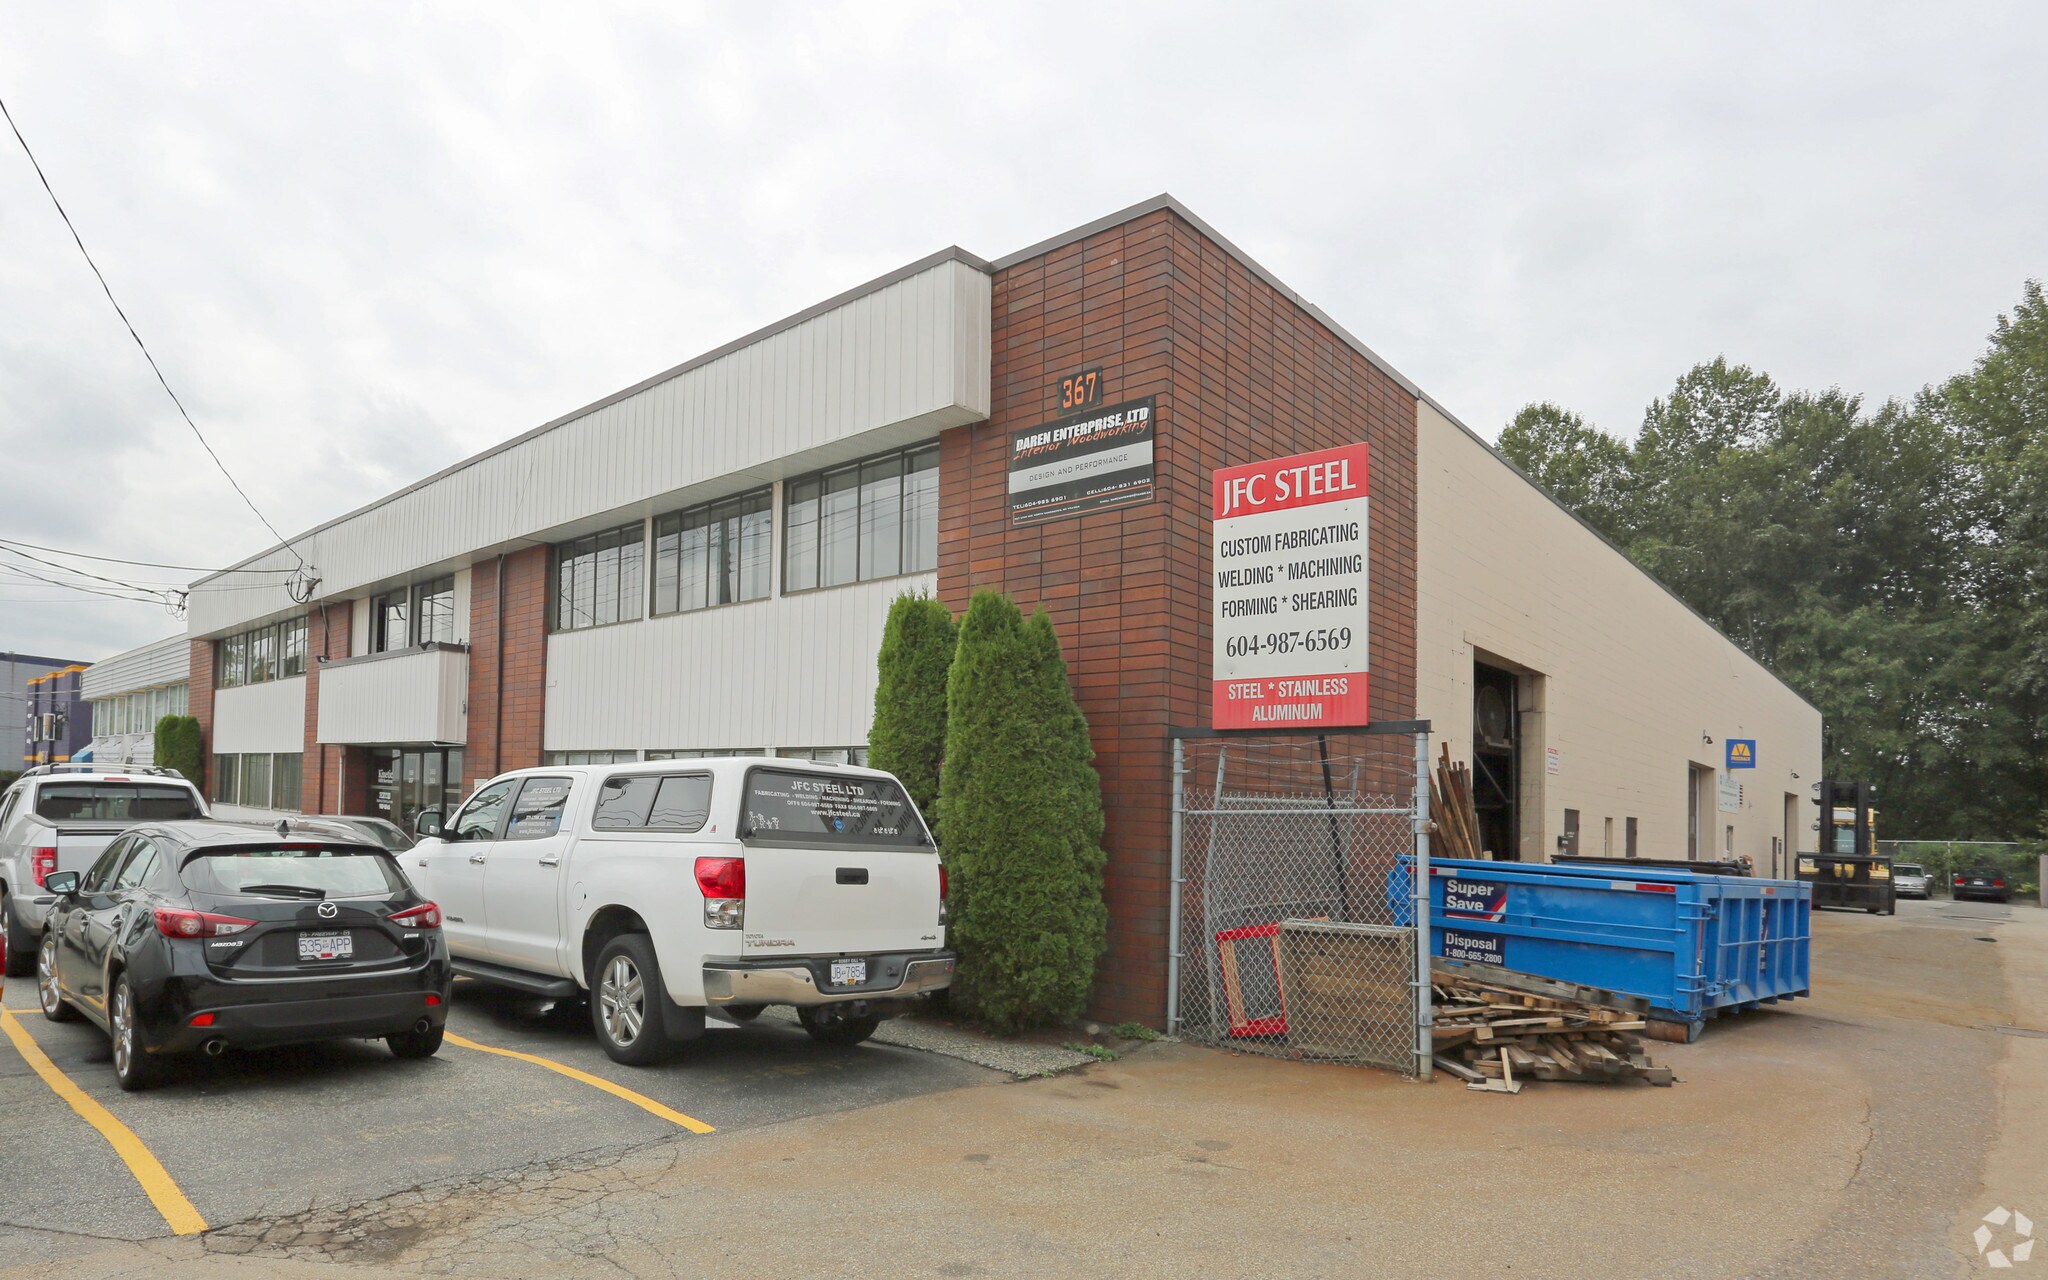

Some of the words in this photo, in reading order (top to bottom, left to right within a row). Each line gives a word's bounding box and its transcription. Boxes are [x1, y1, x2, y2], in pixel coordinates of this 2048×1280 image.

[1063, 372, 1097, 409] 367
[1016, 431, 1051, 451] DAREN
[1126, 407, 1149, 423] LTD
[1013, 441, 1062, 461] Interior
[1067, 419, 1148, 447] Woodworking
[1029, 470, 1055, 482] DESIGN
[1058, 466, 1073, 475] AND
[1075, 453, 1128, 471] PERFORMANCE
[1133, 478, 1150, 486] 6902
[1221, 473, 1266, 516] JFC
[1274, 459, 1356, 502] STEEL
[1220, 535, 1271, 558] CUSTOM
[1275, 522, 1359, 551] FABRICATING
[1218, 565, 1273, 588] WELDING
[1288, 554, 1362, 581] MACHINING
[1222, 596, 1277, 618] FORMING
[1292, 587, 1357, 612] SHEARING
[1226, 627, 1352, 658] 604-987-6569
[1228, 682, 1264, 700] STEEL
[1278, 678, 1348, 698] STAINLESS
[1252, 703, 1323, 722] ALUMINUM
[754, 790, 790, 798] FABRICATING
[822, 795, 850, 803] MACHINING
[852, 797, 877, 805] SHEARING
[791, 781, 811, 791] JFC
[812, 782, 845, 795] STEEL
[845, 785, 864, 796] LTD
[810, 809, 860, 818] www.jfcsteel.ca
[1447, 879, 1494, 897] Super
[1446, 895, 1484, 911] Save
[300, 939, 322, 953] 535
[330, 937, 351, 951] APP
[1446, 932, 1497, 951] Disposal
[1445, 948, 1502, 964] 1-800-665-2800
[845, 965, 865, 979] 7854
